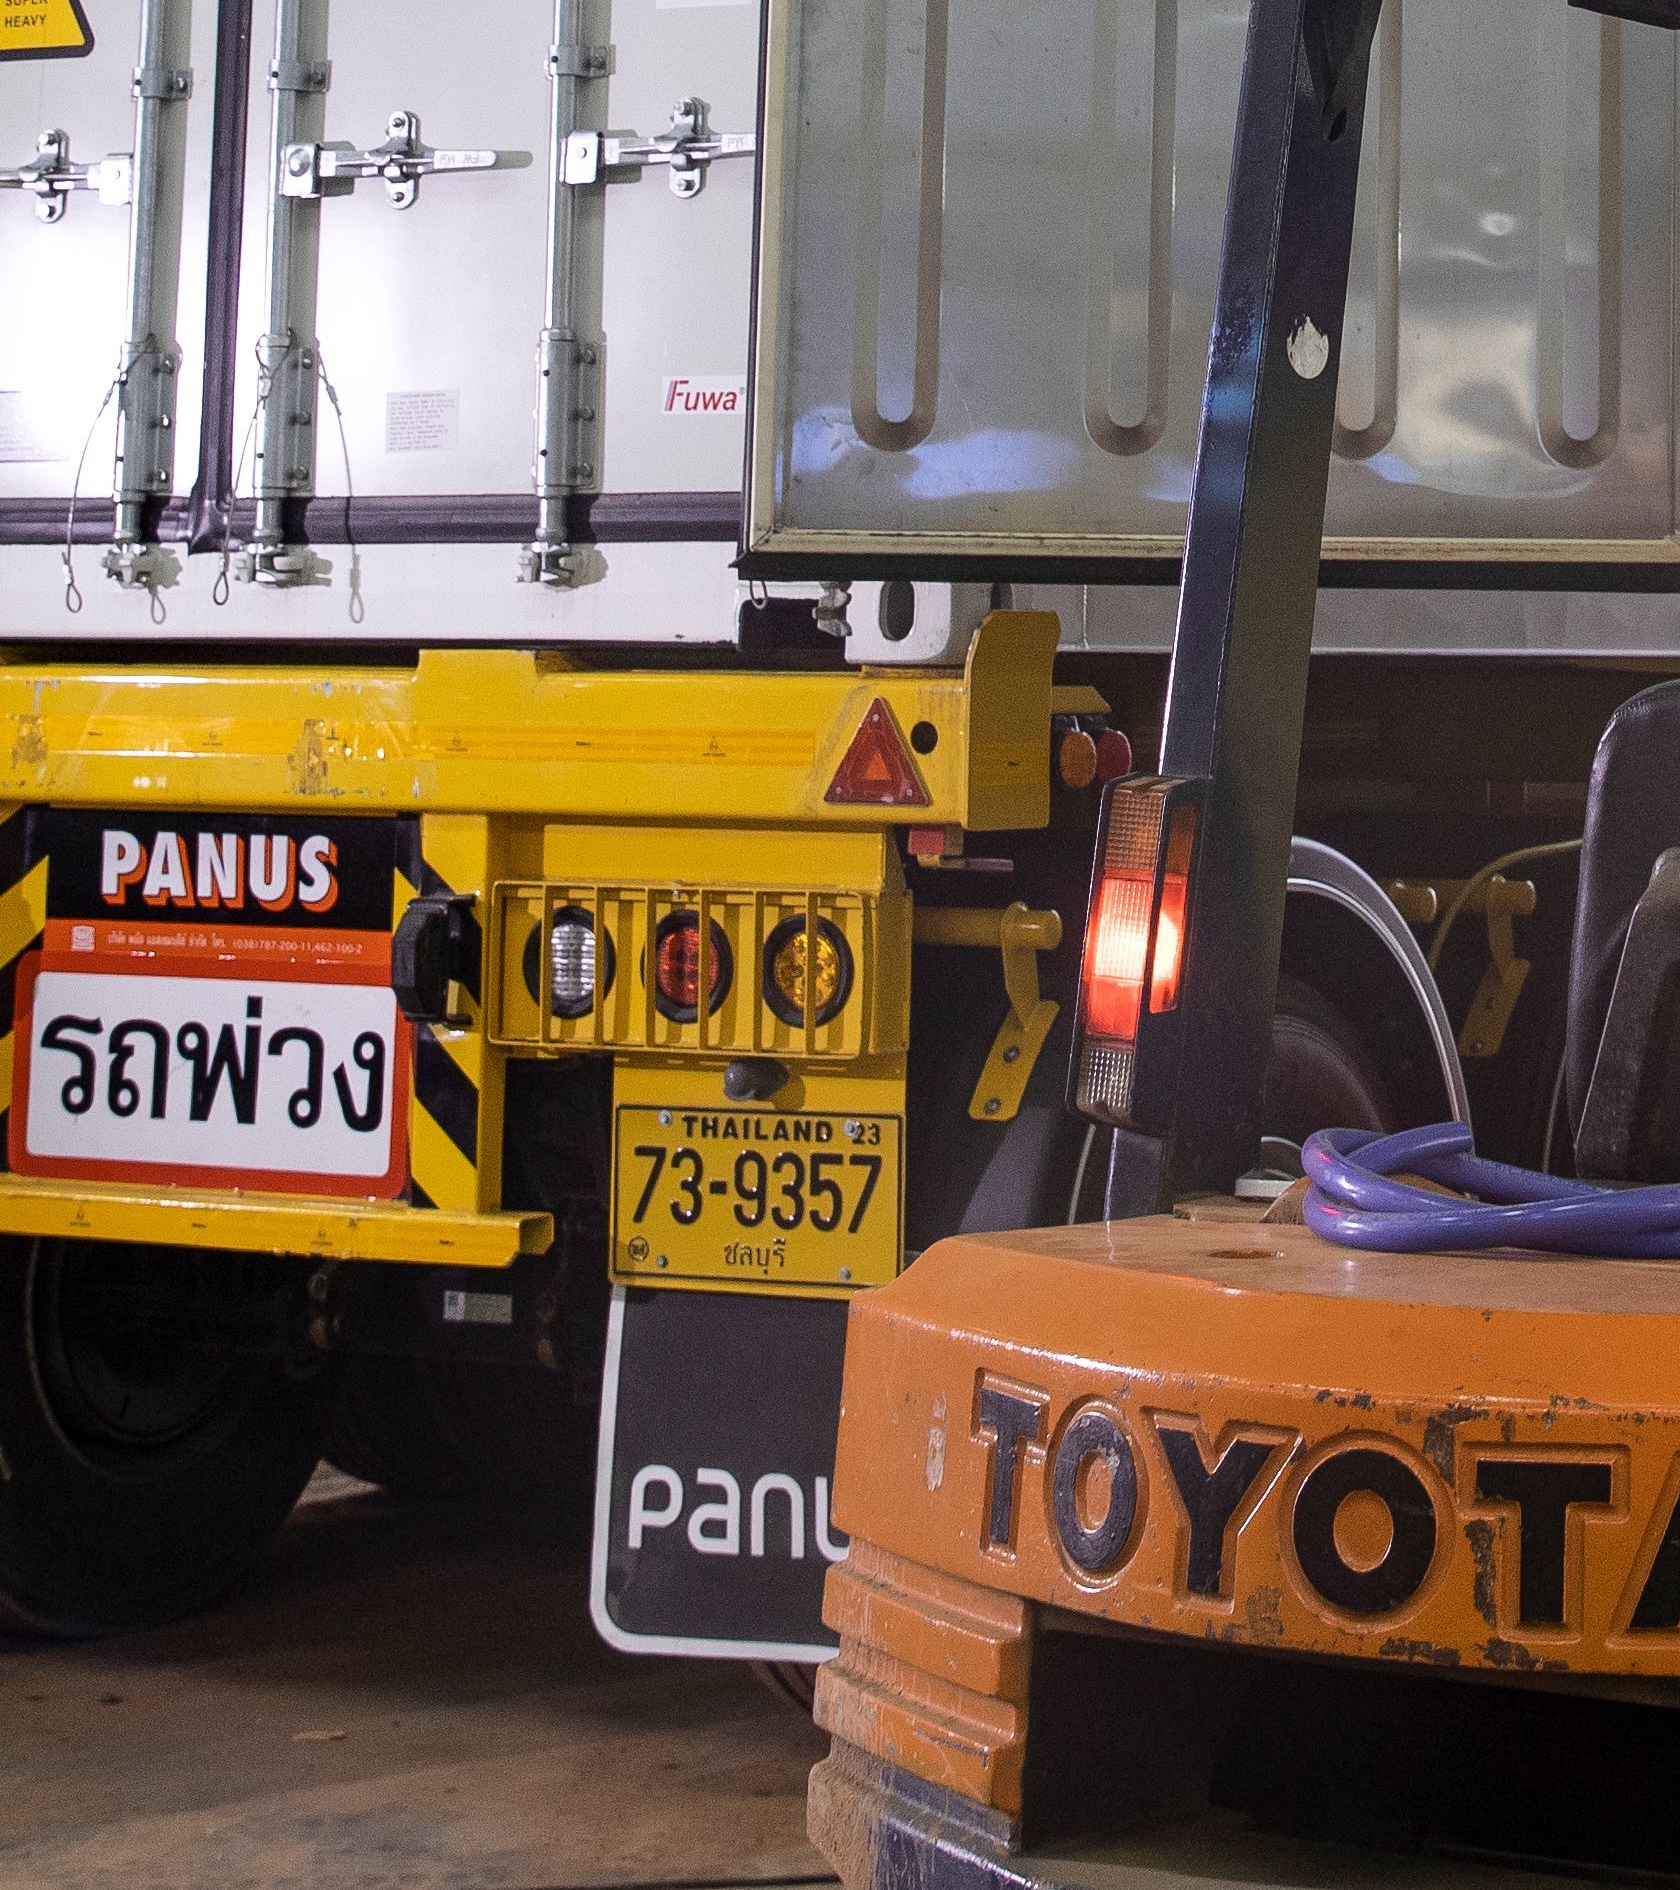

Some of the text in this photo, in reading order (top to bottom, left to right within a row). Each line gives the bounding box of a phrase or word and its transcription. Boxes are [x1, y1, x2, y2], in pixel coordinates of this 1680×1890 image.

[5, 13, 47, 29] HEAVY
[663, 379, 738, 412] Fuwa
[100, 828, 338, 913] PANUS
[40, 994, 386, 1133] รถพ่วง
[682, 1114, 834, 1143] THAILAND
[633, 1145, 883, 1235] 73-9357
[723, 1237, 786, 1275] ชลบุรี
